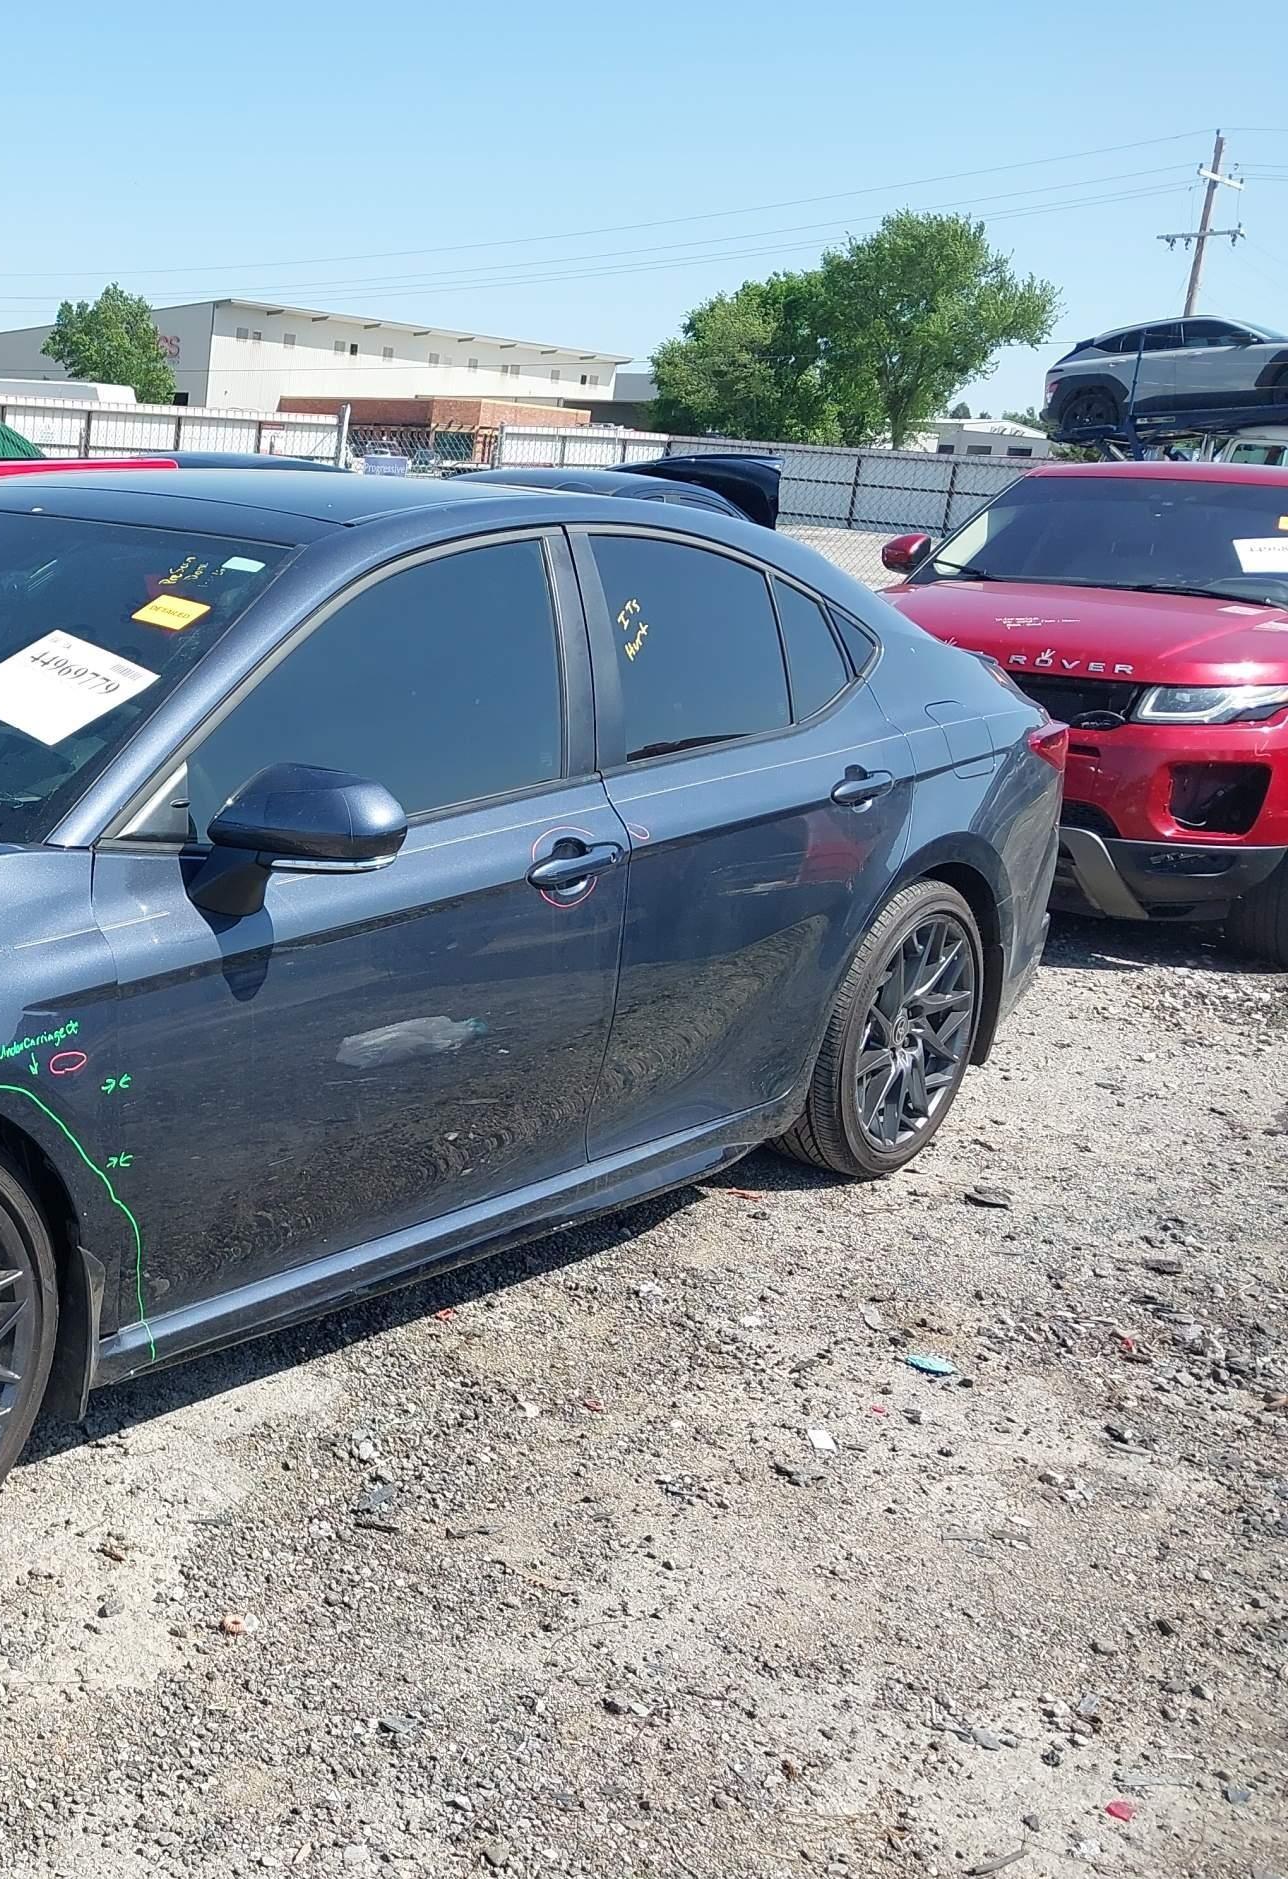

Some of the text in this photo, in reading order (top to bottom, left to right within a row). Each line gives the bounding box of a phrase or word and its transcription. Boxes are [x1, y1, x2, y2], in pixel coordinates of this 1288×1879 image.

[364, 462, 407, 474] Progressive
[149, 605, 191, 619] DETAILED
[30, 650, 121, 695] 44969779
[1008, 654, 1135, 676] ROVER
